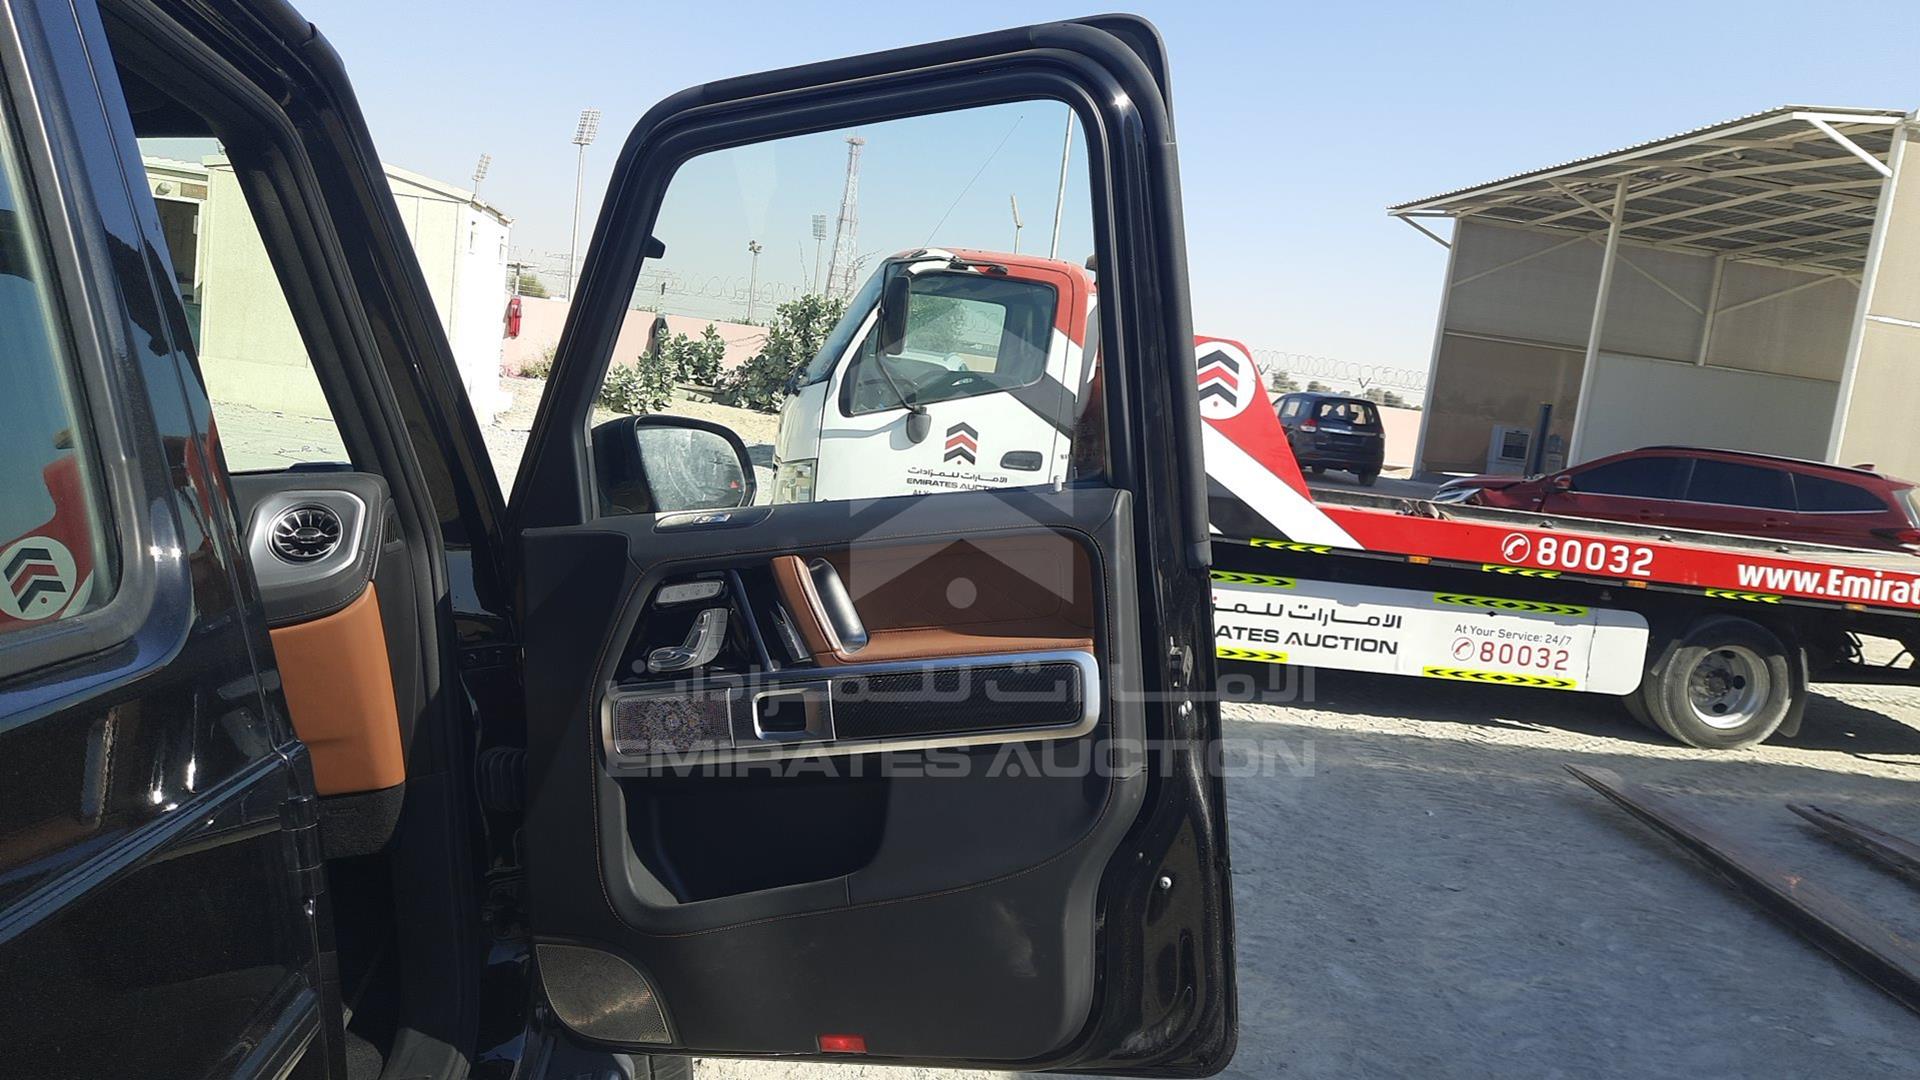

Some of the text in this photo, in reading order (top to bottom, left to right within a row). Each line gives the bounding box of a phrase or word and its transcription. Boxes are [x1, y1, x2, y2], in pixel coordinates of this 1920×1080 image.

[906, 477, 958, 490] EMIRATES
[1536, 537, 1654, 577] 80032
[1215, 624, 1398, 655] ATES AUCTION
[1454, 624, 1572, 646] At Your Service: 24/7
[1479, 641, 1569, 671] 80032
